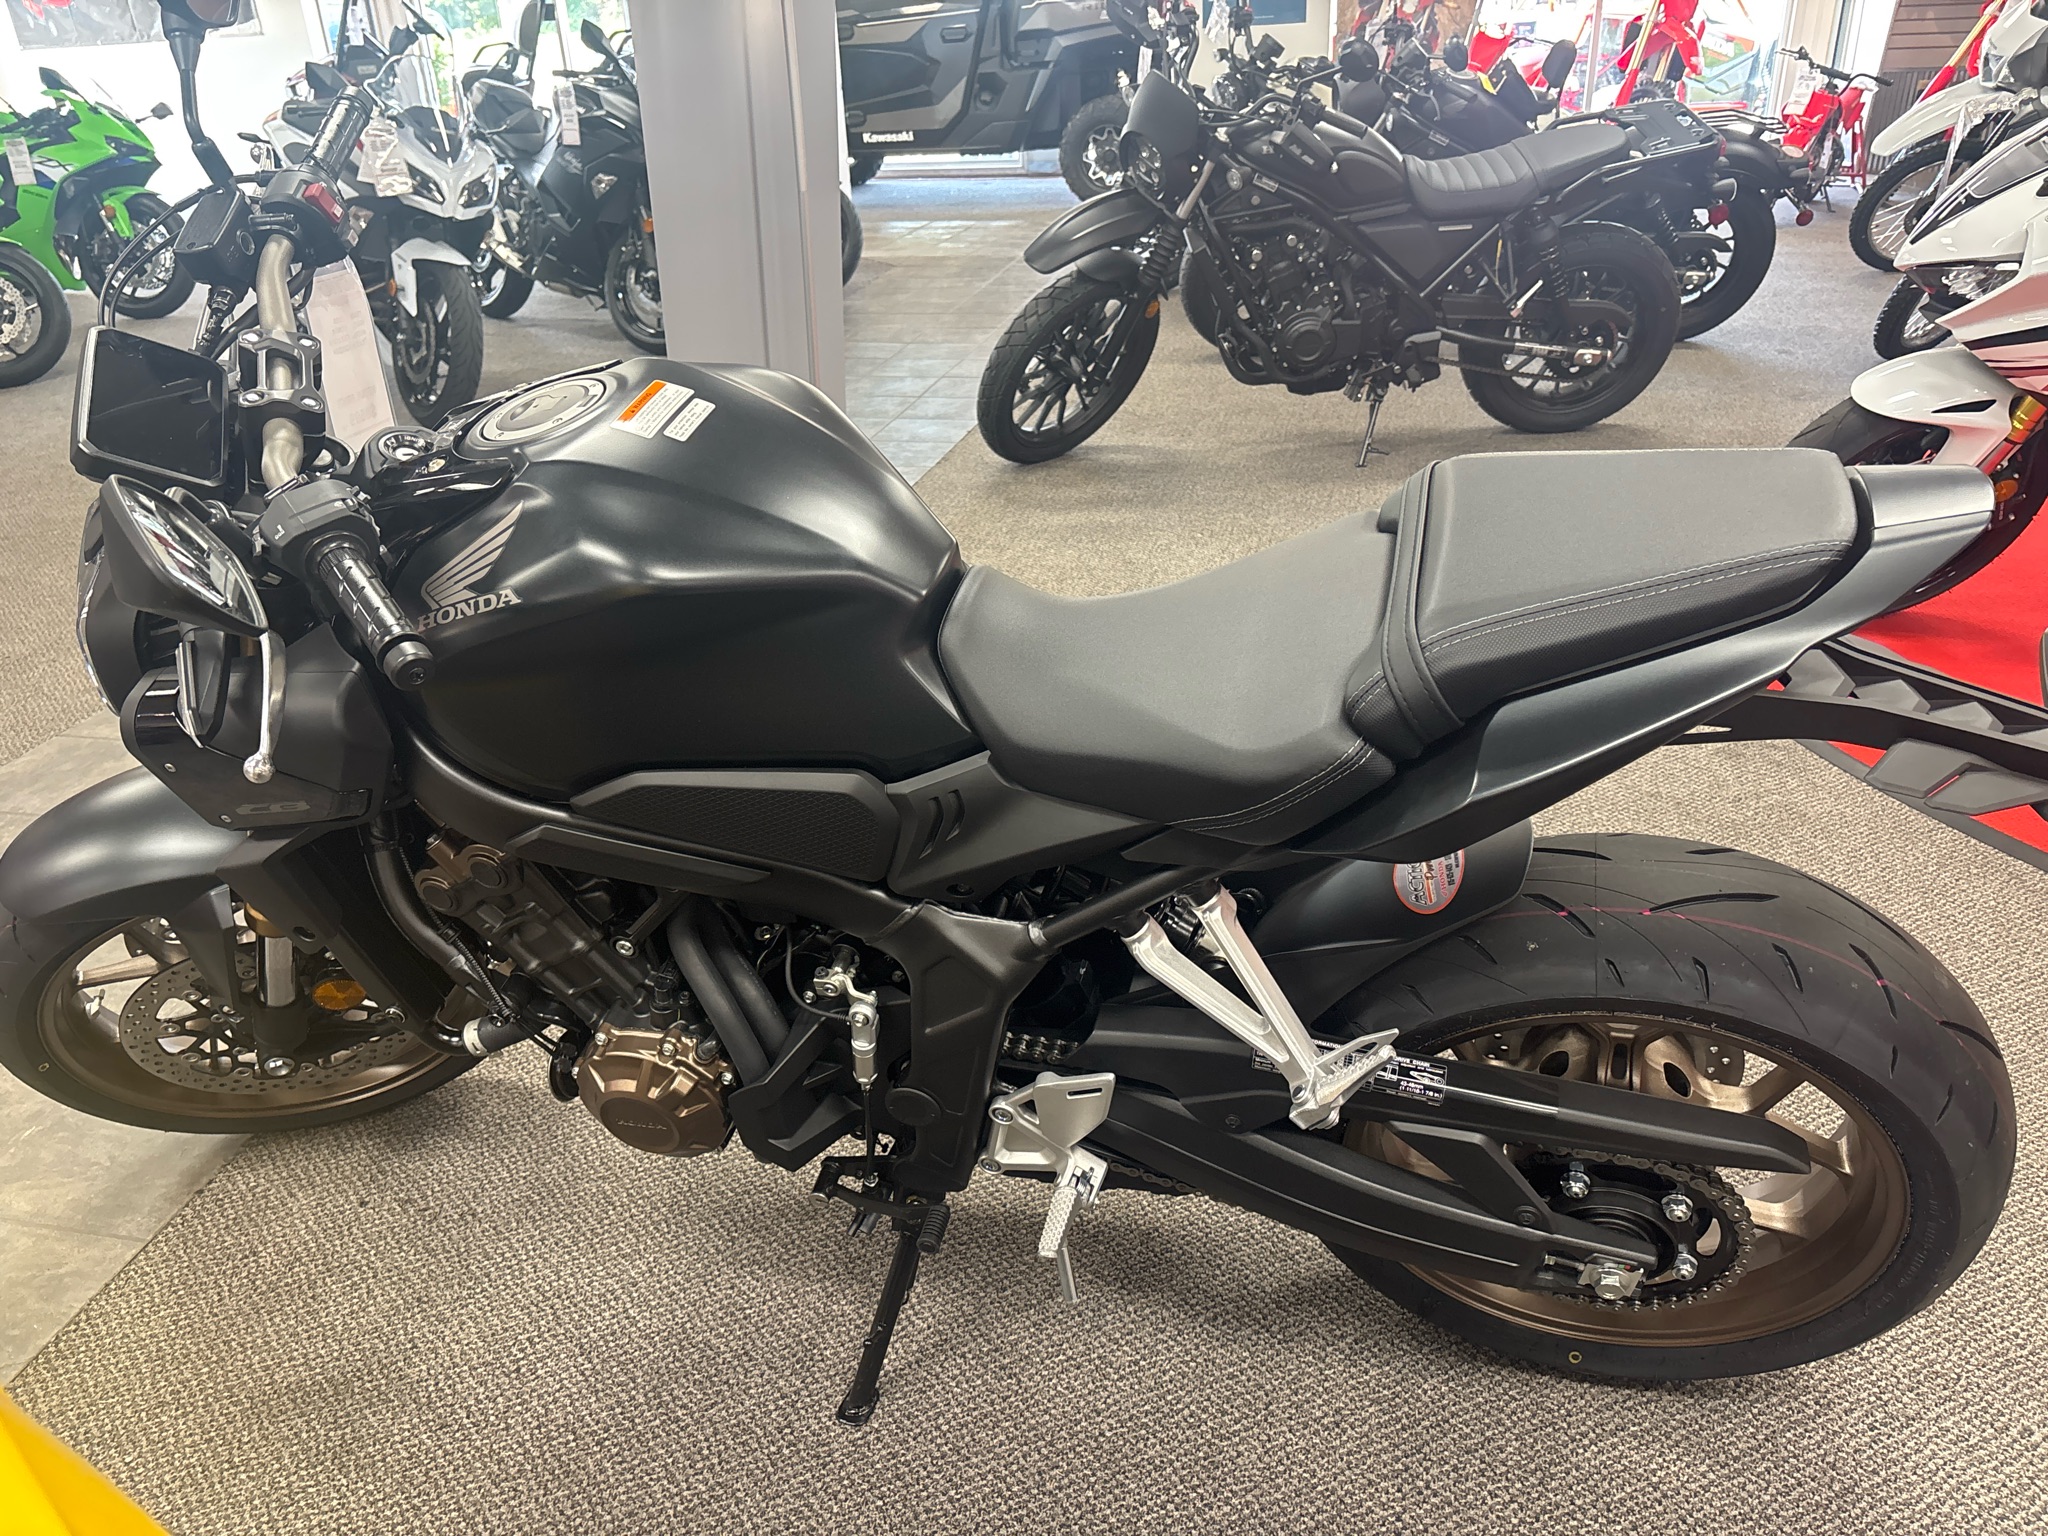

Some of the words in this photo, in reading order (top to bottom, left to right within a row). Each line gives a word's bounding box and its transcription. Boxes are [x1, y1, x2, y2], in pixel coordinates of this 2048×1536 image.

[863, 131, 914, 144] Kawasaki
[417, 588, 522, 633] HONDA
[236, 800, 311, 815] CB
[1437, 860, 1447, 891] HONDA
[616, 1118, 667, 1130] HONDA
